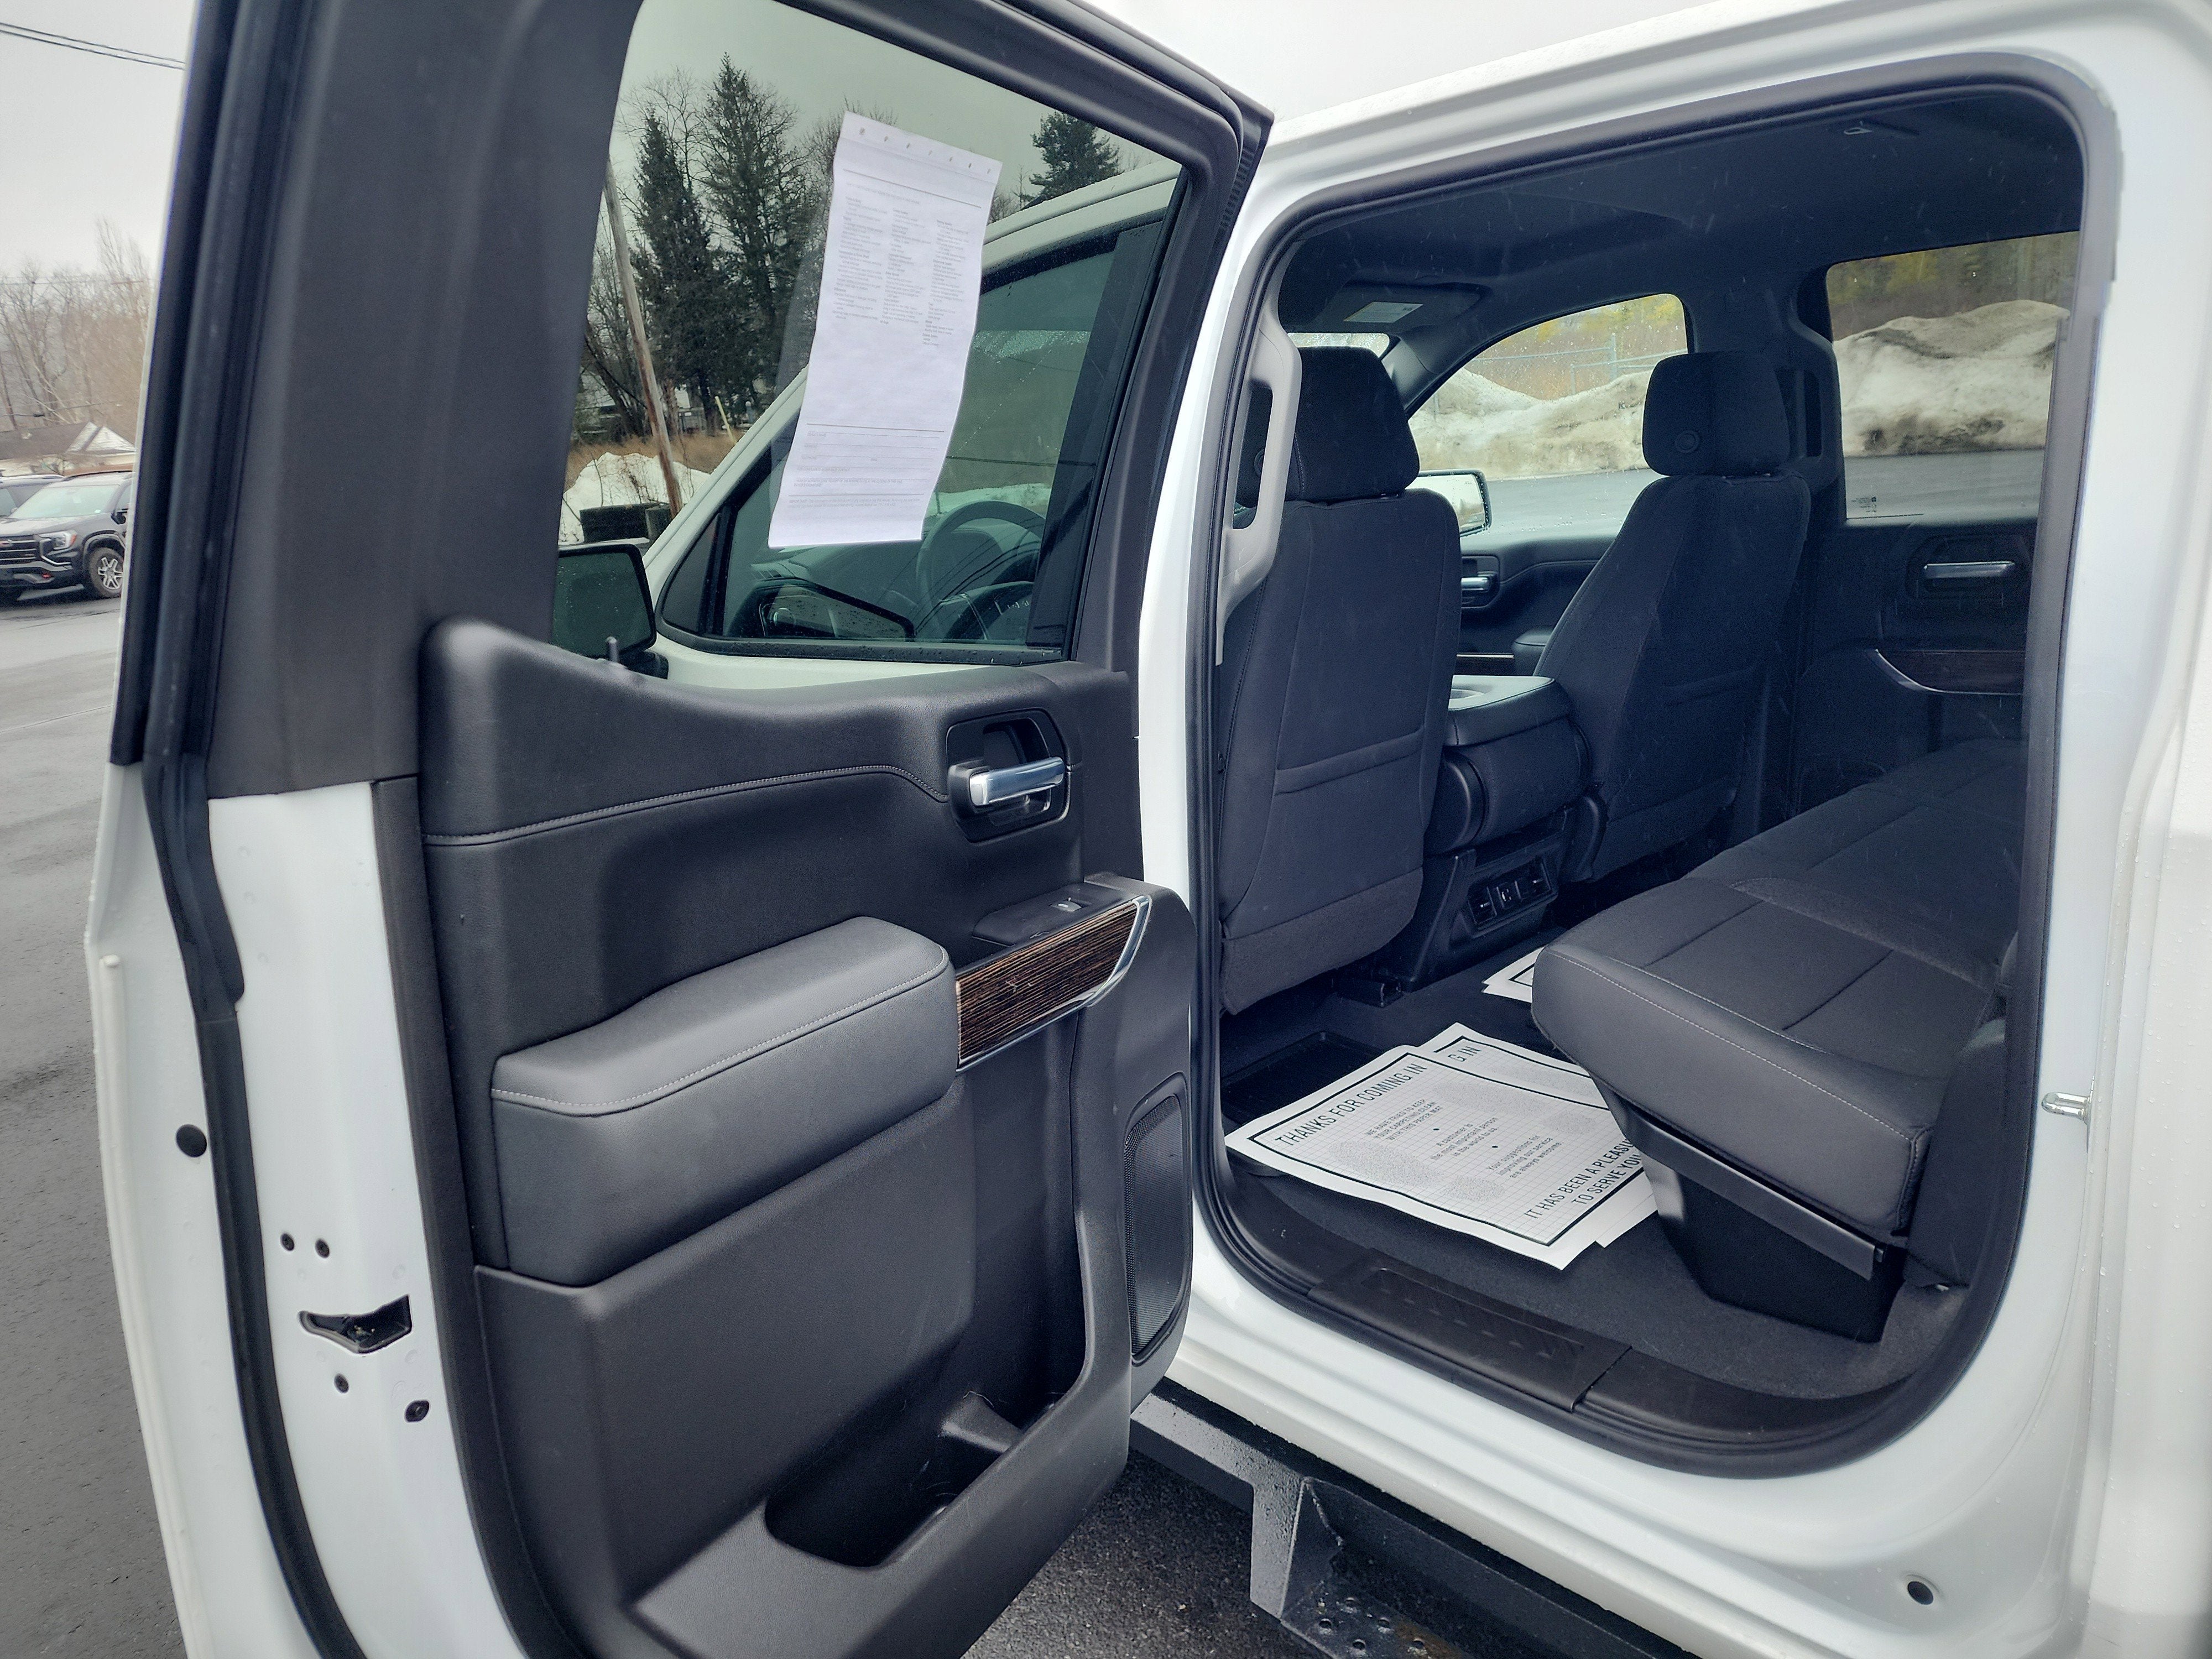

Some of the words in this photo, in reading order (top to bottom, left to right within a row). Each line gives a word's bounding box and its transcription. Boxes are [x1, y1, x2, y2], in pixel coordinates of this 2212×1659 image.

[1458, 1046, 1482, 1056] IN
[1275, 1115, 1337, 1146] THANKS
[1328, 1099, 1364, 1117] FOR
[1356, 1073, 1412, 1100] COMING
[1403, 1063, 1427, 1074] IN
[1524, 1209, 1542, 1219] IT
[1536, 1193, 1565, 1210] HAS
[1558, 1173, 1592, 1193] BEEN
[1592, 1138, 1634, 1168] PLEASU
[1571, 1194, 1594, 1204] TO
[1587, 1170, 1626, 1193] SERVE
